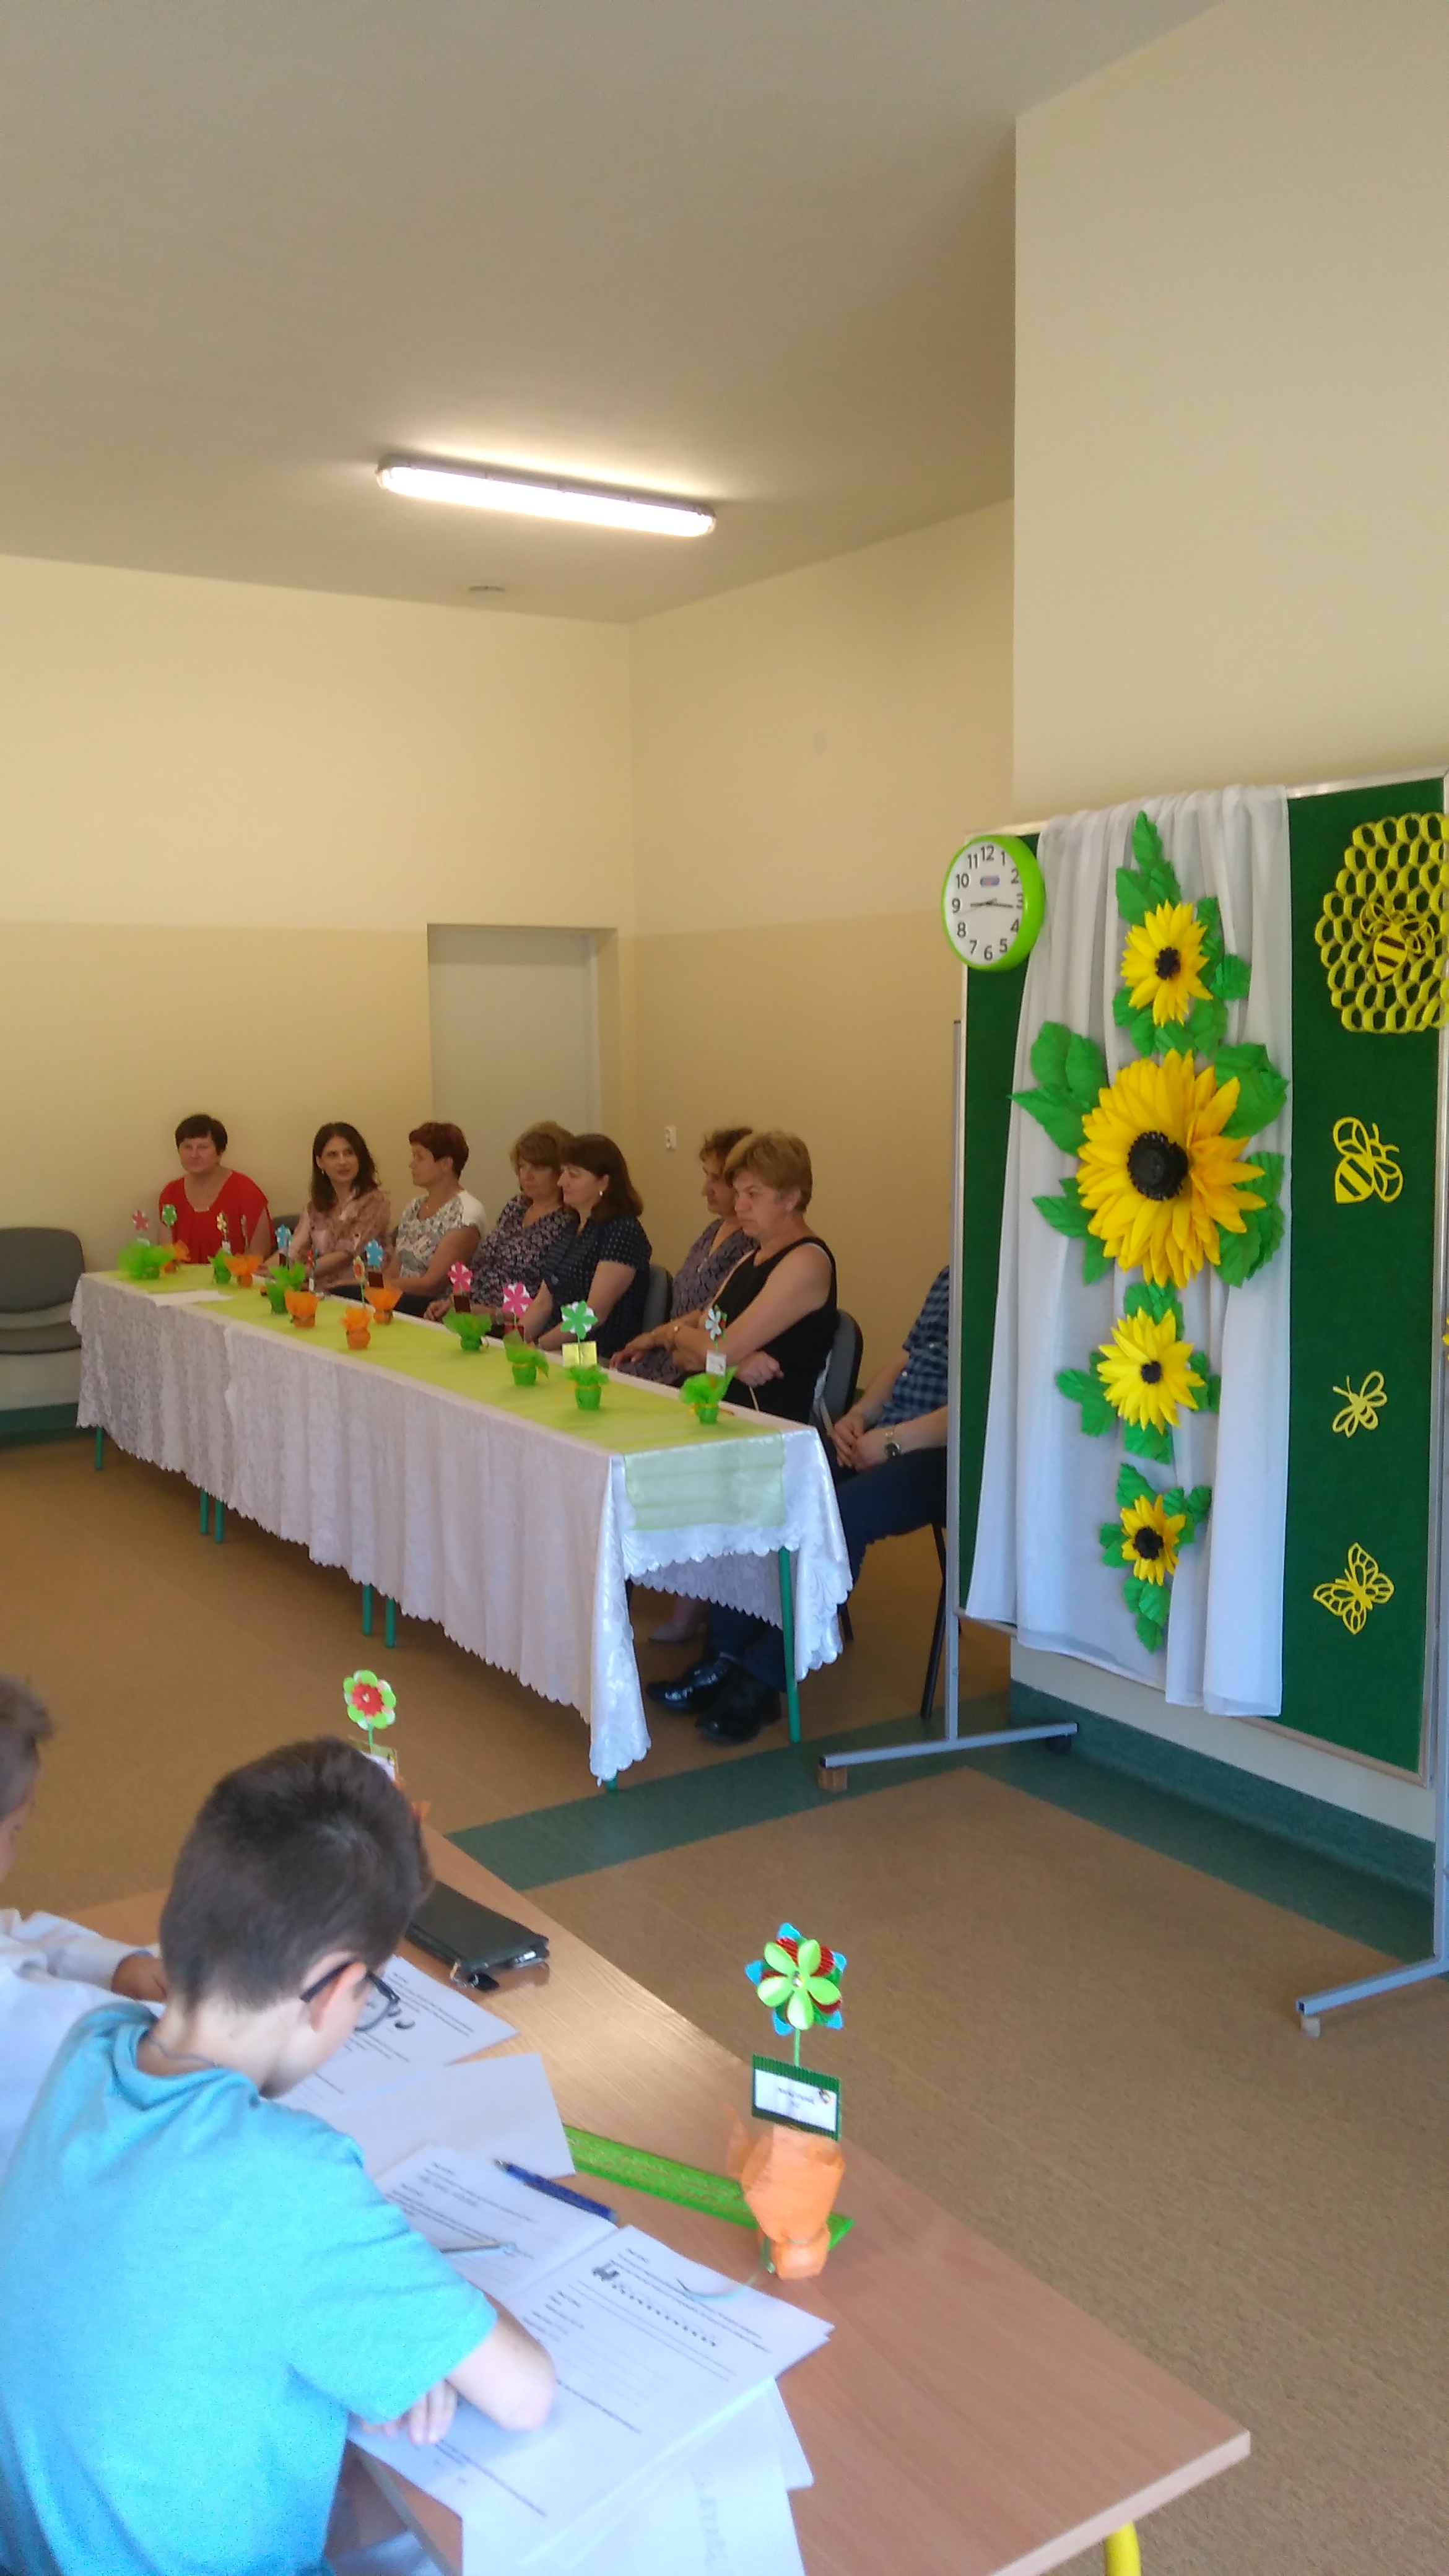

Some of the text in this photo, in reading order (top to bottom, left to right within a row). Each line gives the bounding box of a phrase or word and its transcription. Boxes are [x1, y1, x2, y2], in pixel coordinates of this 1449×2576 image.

[981, 845, 994, 861] 12
[1001, 851, 1006, 866] 1
[967, 853, 978, 869] 11
[956, 873, 969, 889] 10
[1011, 869, 1019, 884] 2
[952, 898, 960, 913] 9
[1016, 892, 1023, 910] 3
[957, 922, 967, 938] 8
[1010, 918, 1019, 933] 4
[970, 939, 977, 954] 7
[984, 946, 993, 960] 6
[999, 938, 1007, 953] 5
